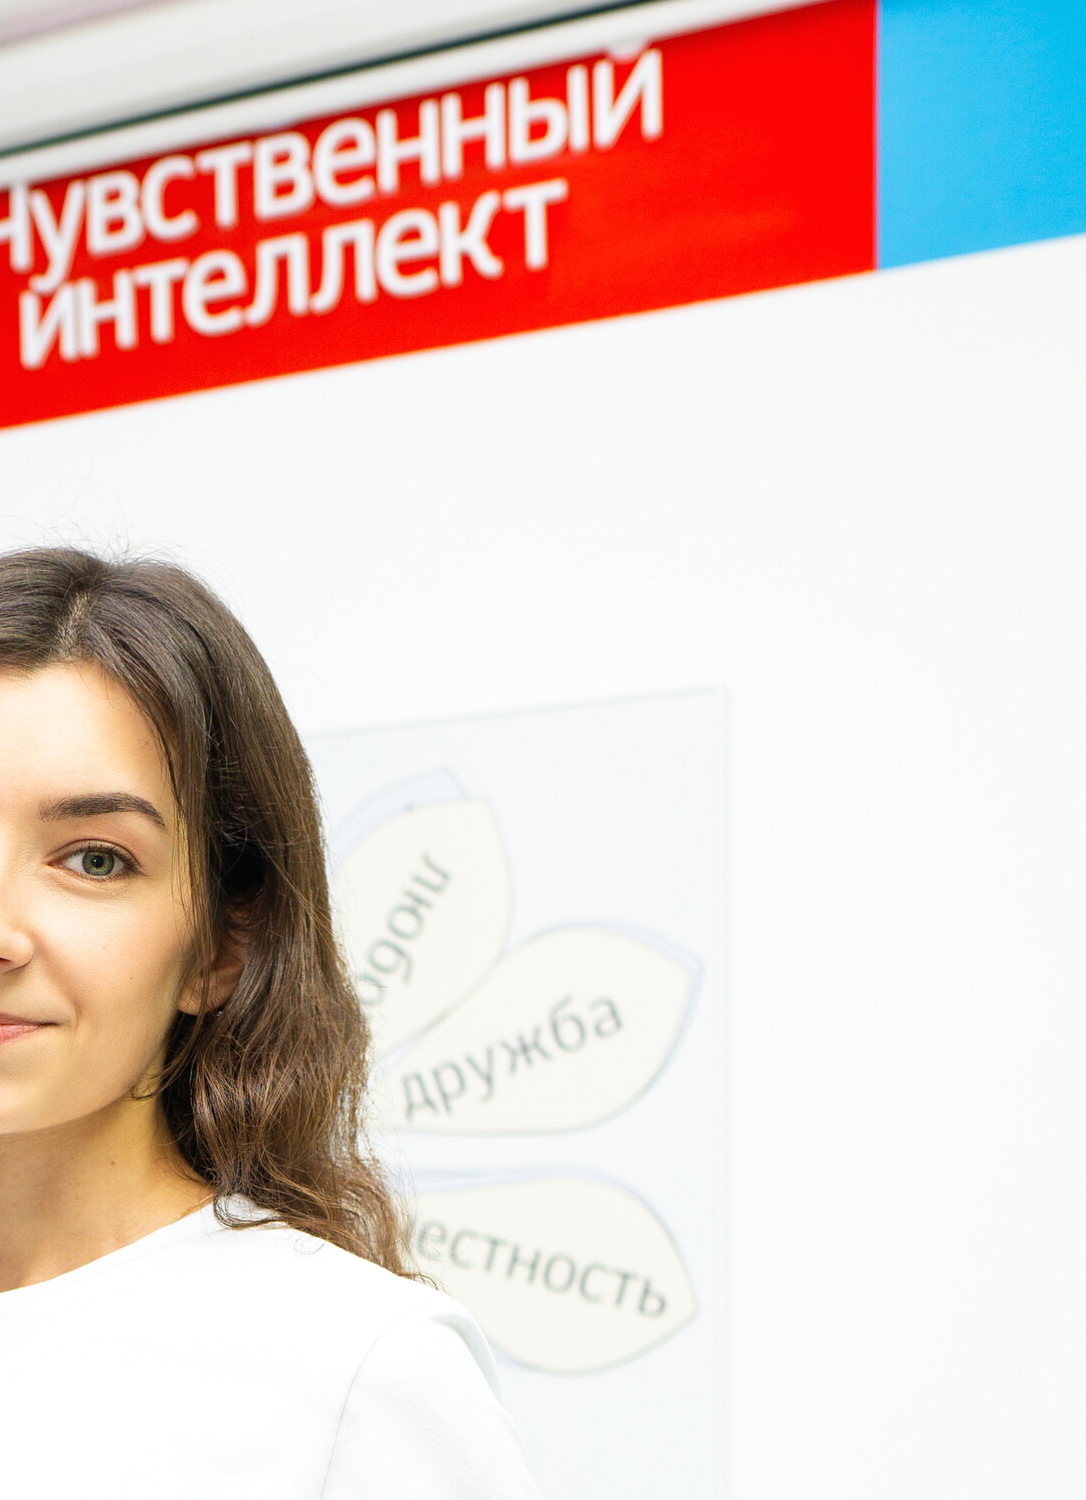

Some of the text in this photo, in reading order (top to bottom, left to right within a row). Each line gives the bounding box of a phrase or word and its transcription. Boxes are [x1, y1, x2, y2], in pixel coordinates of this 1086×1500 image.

[18, 178, 568, 369] интеллект
[355, 849, 452, 1007] любо
[399, 994, 625, 1123] дружба
[415, 1219, 668, 1320] естность
